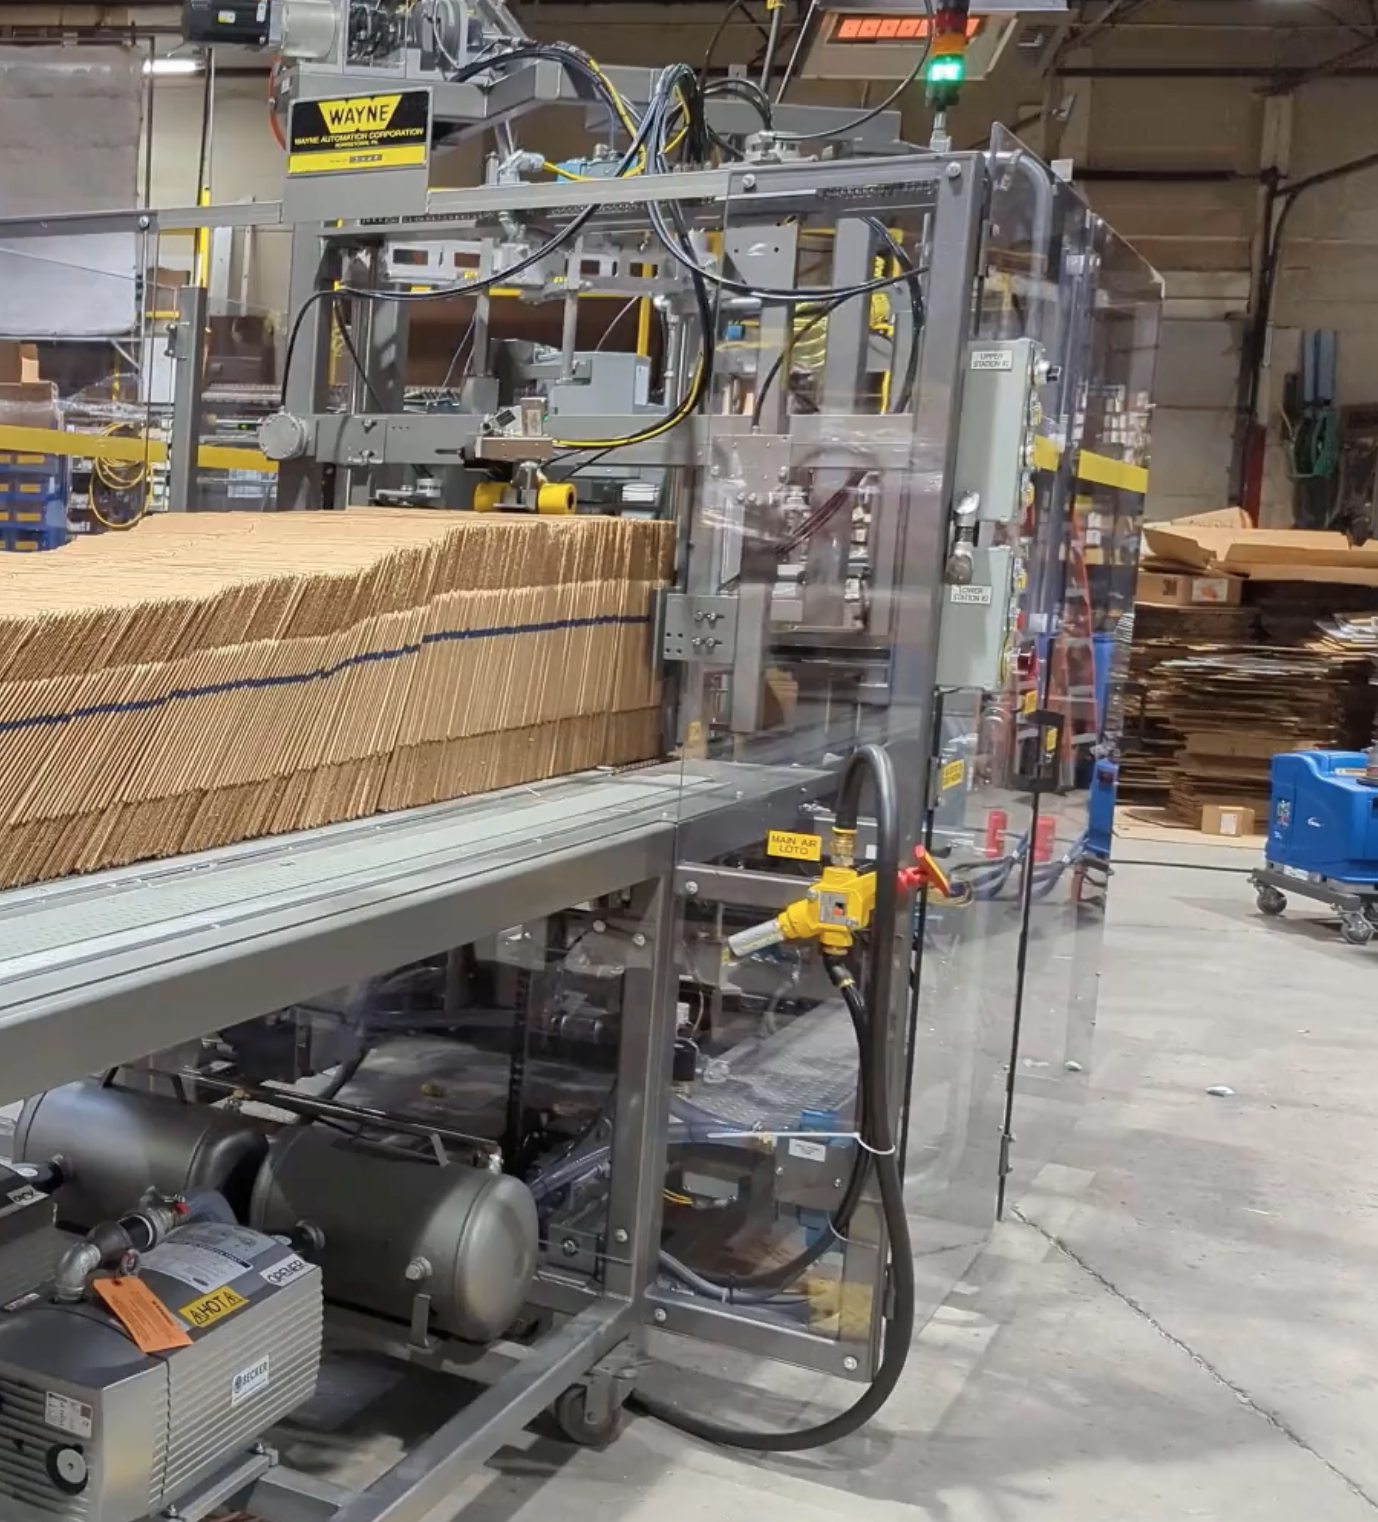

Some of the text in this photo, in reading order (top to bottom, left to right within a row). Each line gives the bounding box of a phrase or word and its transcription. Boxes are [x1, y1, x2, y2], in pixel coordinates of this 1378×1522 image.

[329, 104, 390, 126] WAYNE
[294, 128, 424, 146] WAYNE AUTOMATION CORPORATION
[972, 360, 1001, 368] STATION
[772, 835, 818, 848] MAIN AIR
[778, 844, 809, 855] LOTO
[201, 1296, 227, 1320] HOT
[243, 1361, 268, 1386] BECKER
